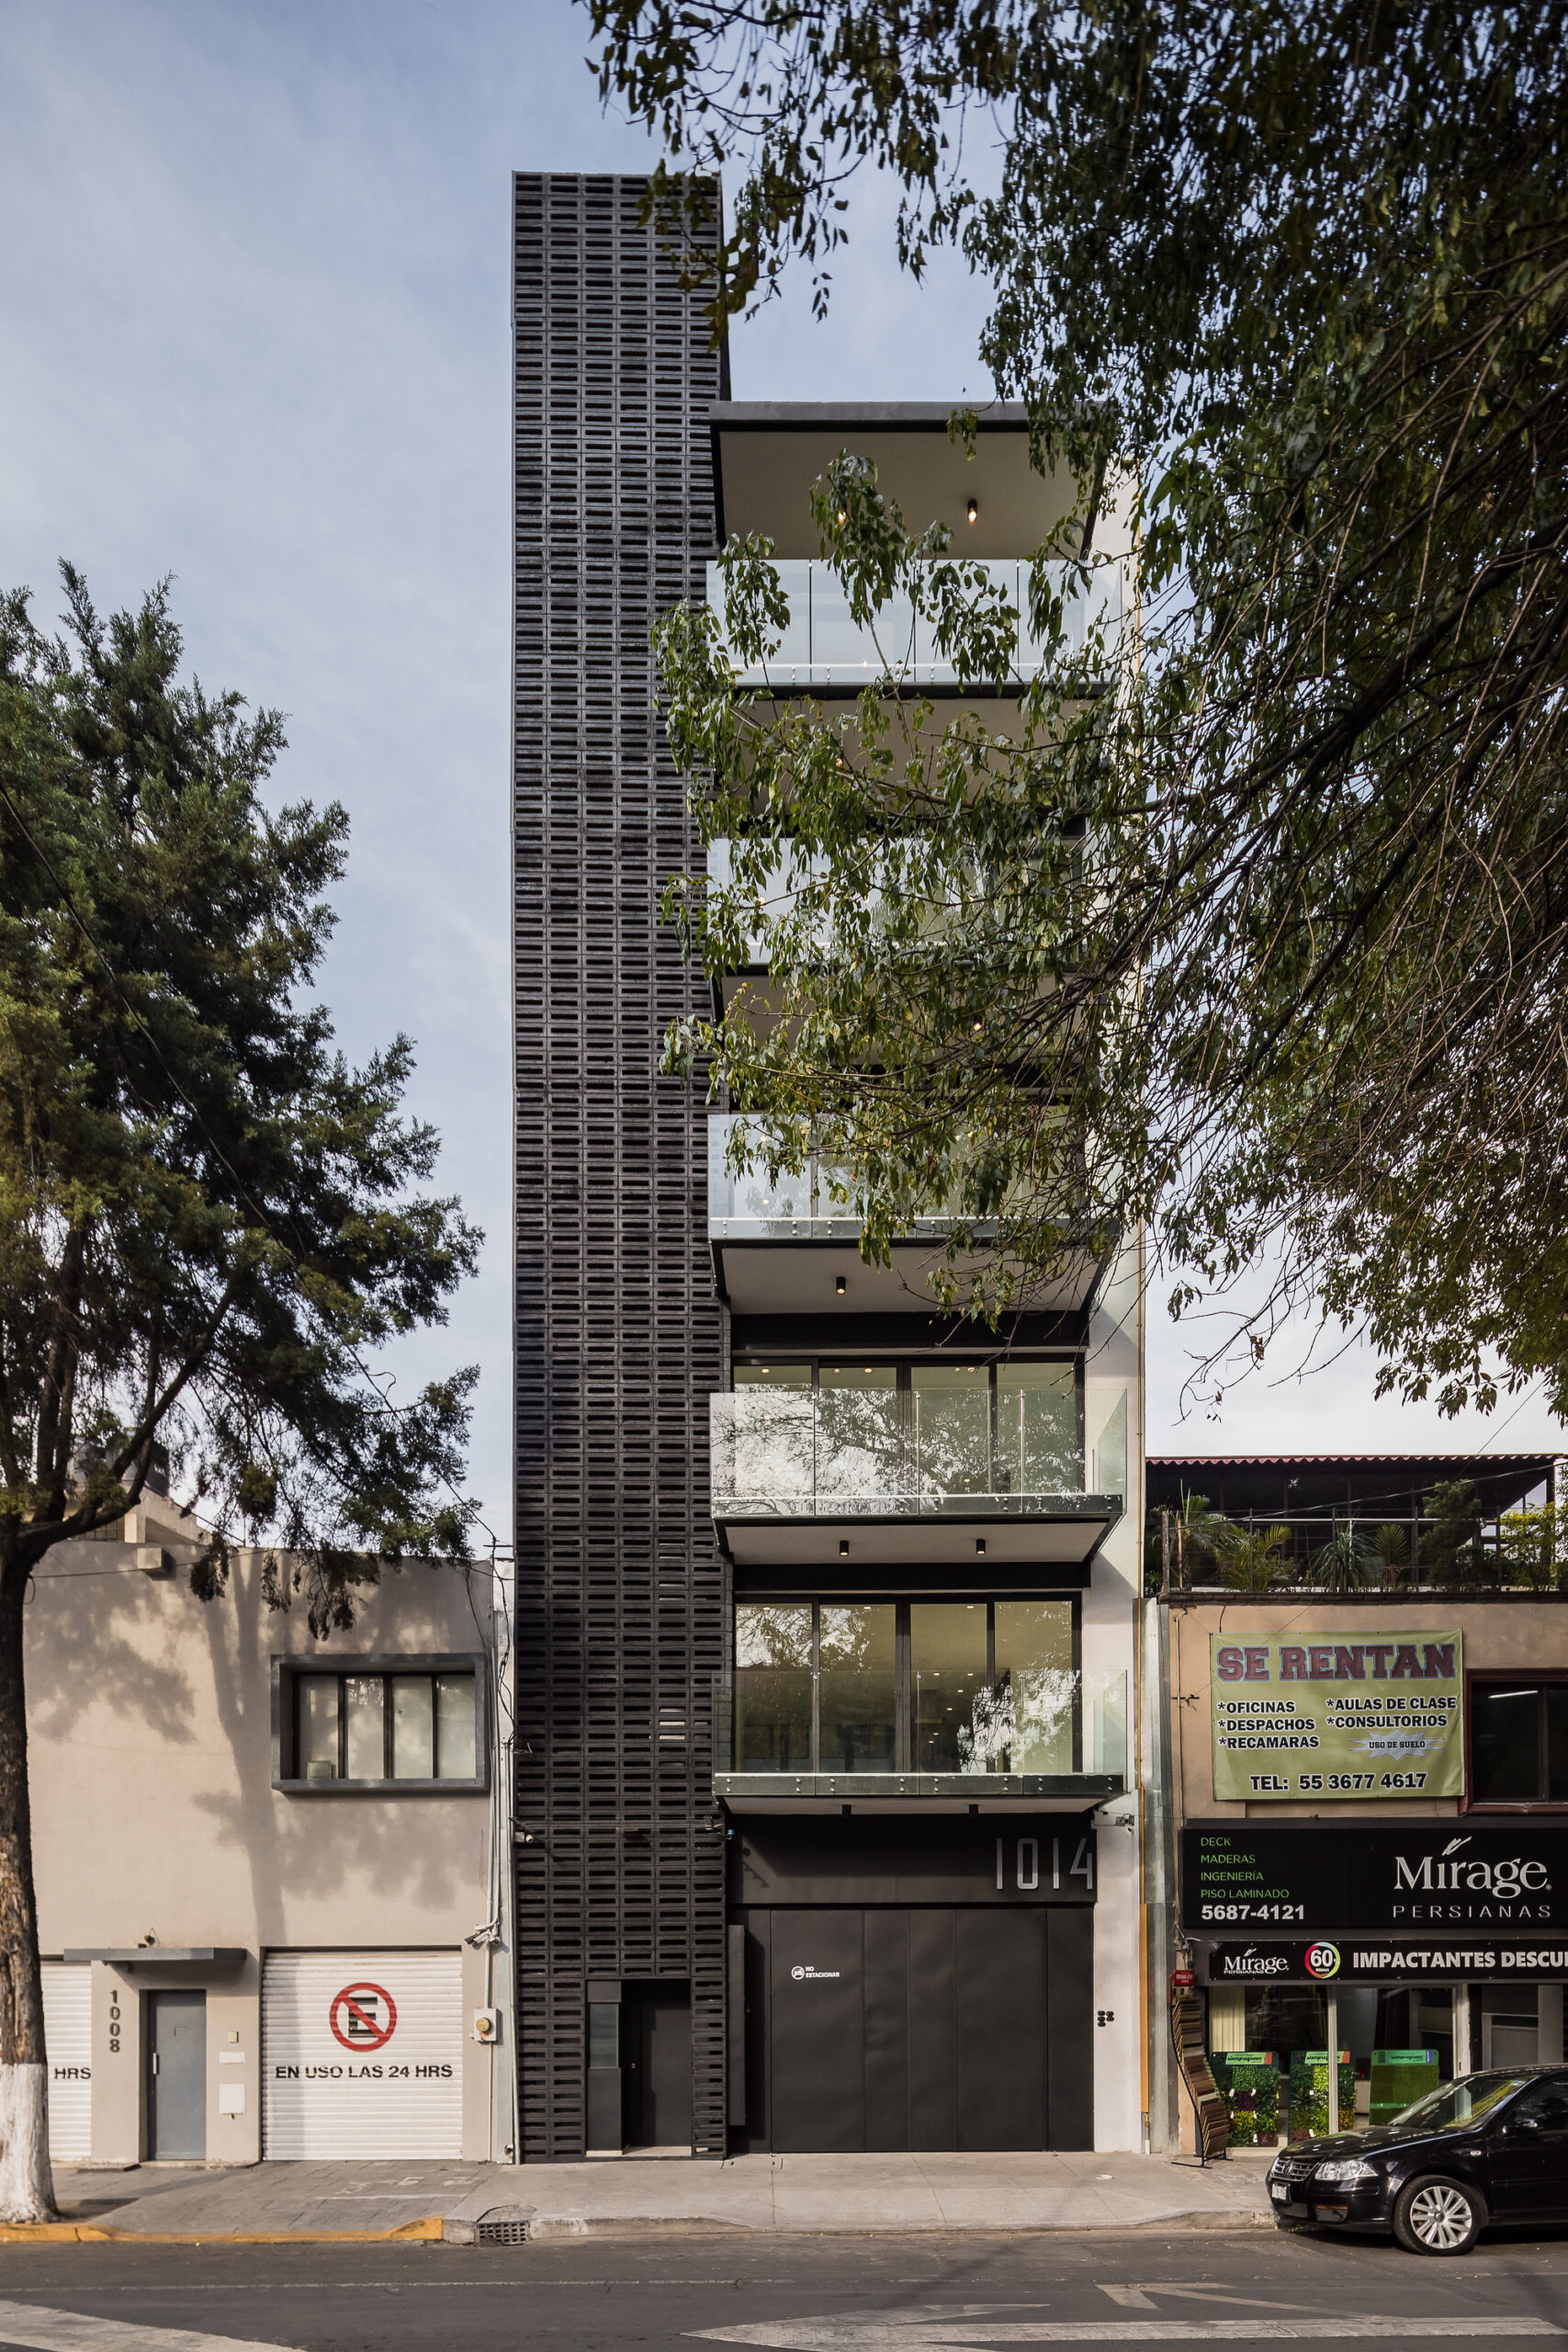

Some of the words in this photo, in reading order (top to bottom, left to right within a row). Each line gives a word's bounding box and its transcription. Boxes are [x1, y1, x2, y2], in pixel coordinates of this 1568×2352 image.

[1216, 1645, 1270, 1682] SE
[1279, 1643, 1457, 1681] RENTAN
[1386, 1698, 1405, 1710] DE
[1409, 1697, 1457, 1709] CLASE
[1369, 1741, 1386, 1749] USO
[1387, 1741, 1398, 1749] DE
[1250, 1775, 1289, 1791] TEL:
[1299, 1774, 1323, 1790] 55
[1328, 1774, 1375, 1789] 3677
[1381, 1773, 1427, 1789] 4617
[1201, 1838, 1231, 1847] DECK
[996, 1838, 1093, 1890] 1014
[1201, 1855, 1256, 1863] MADERAS
[1201, 1871, 1264, 1881] INGENIERÍA
[1201, 1889, 1226, 1898] PISO
[1229, 1889, 1290, 1898] LAMINADO
[1201, 1905, 1304, 1920] 5687-4121
[1393, 1905, 1551, 1917] PERSIANAS
[1353, 1951, 1496, 1968] IMPACTANTES
[1501, 1951, 1568, 1968] DESCU
[54, 2067, 91, 2080] HRS
[276, 2065, 299, 2078] EN
[305, 2065, 344, 2078] USO
[348, 2065, 383, 2078] LAS
[389, 2065, 410, 2078] 24
[415, 2064, 453, 2077] HRS
